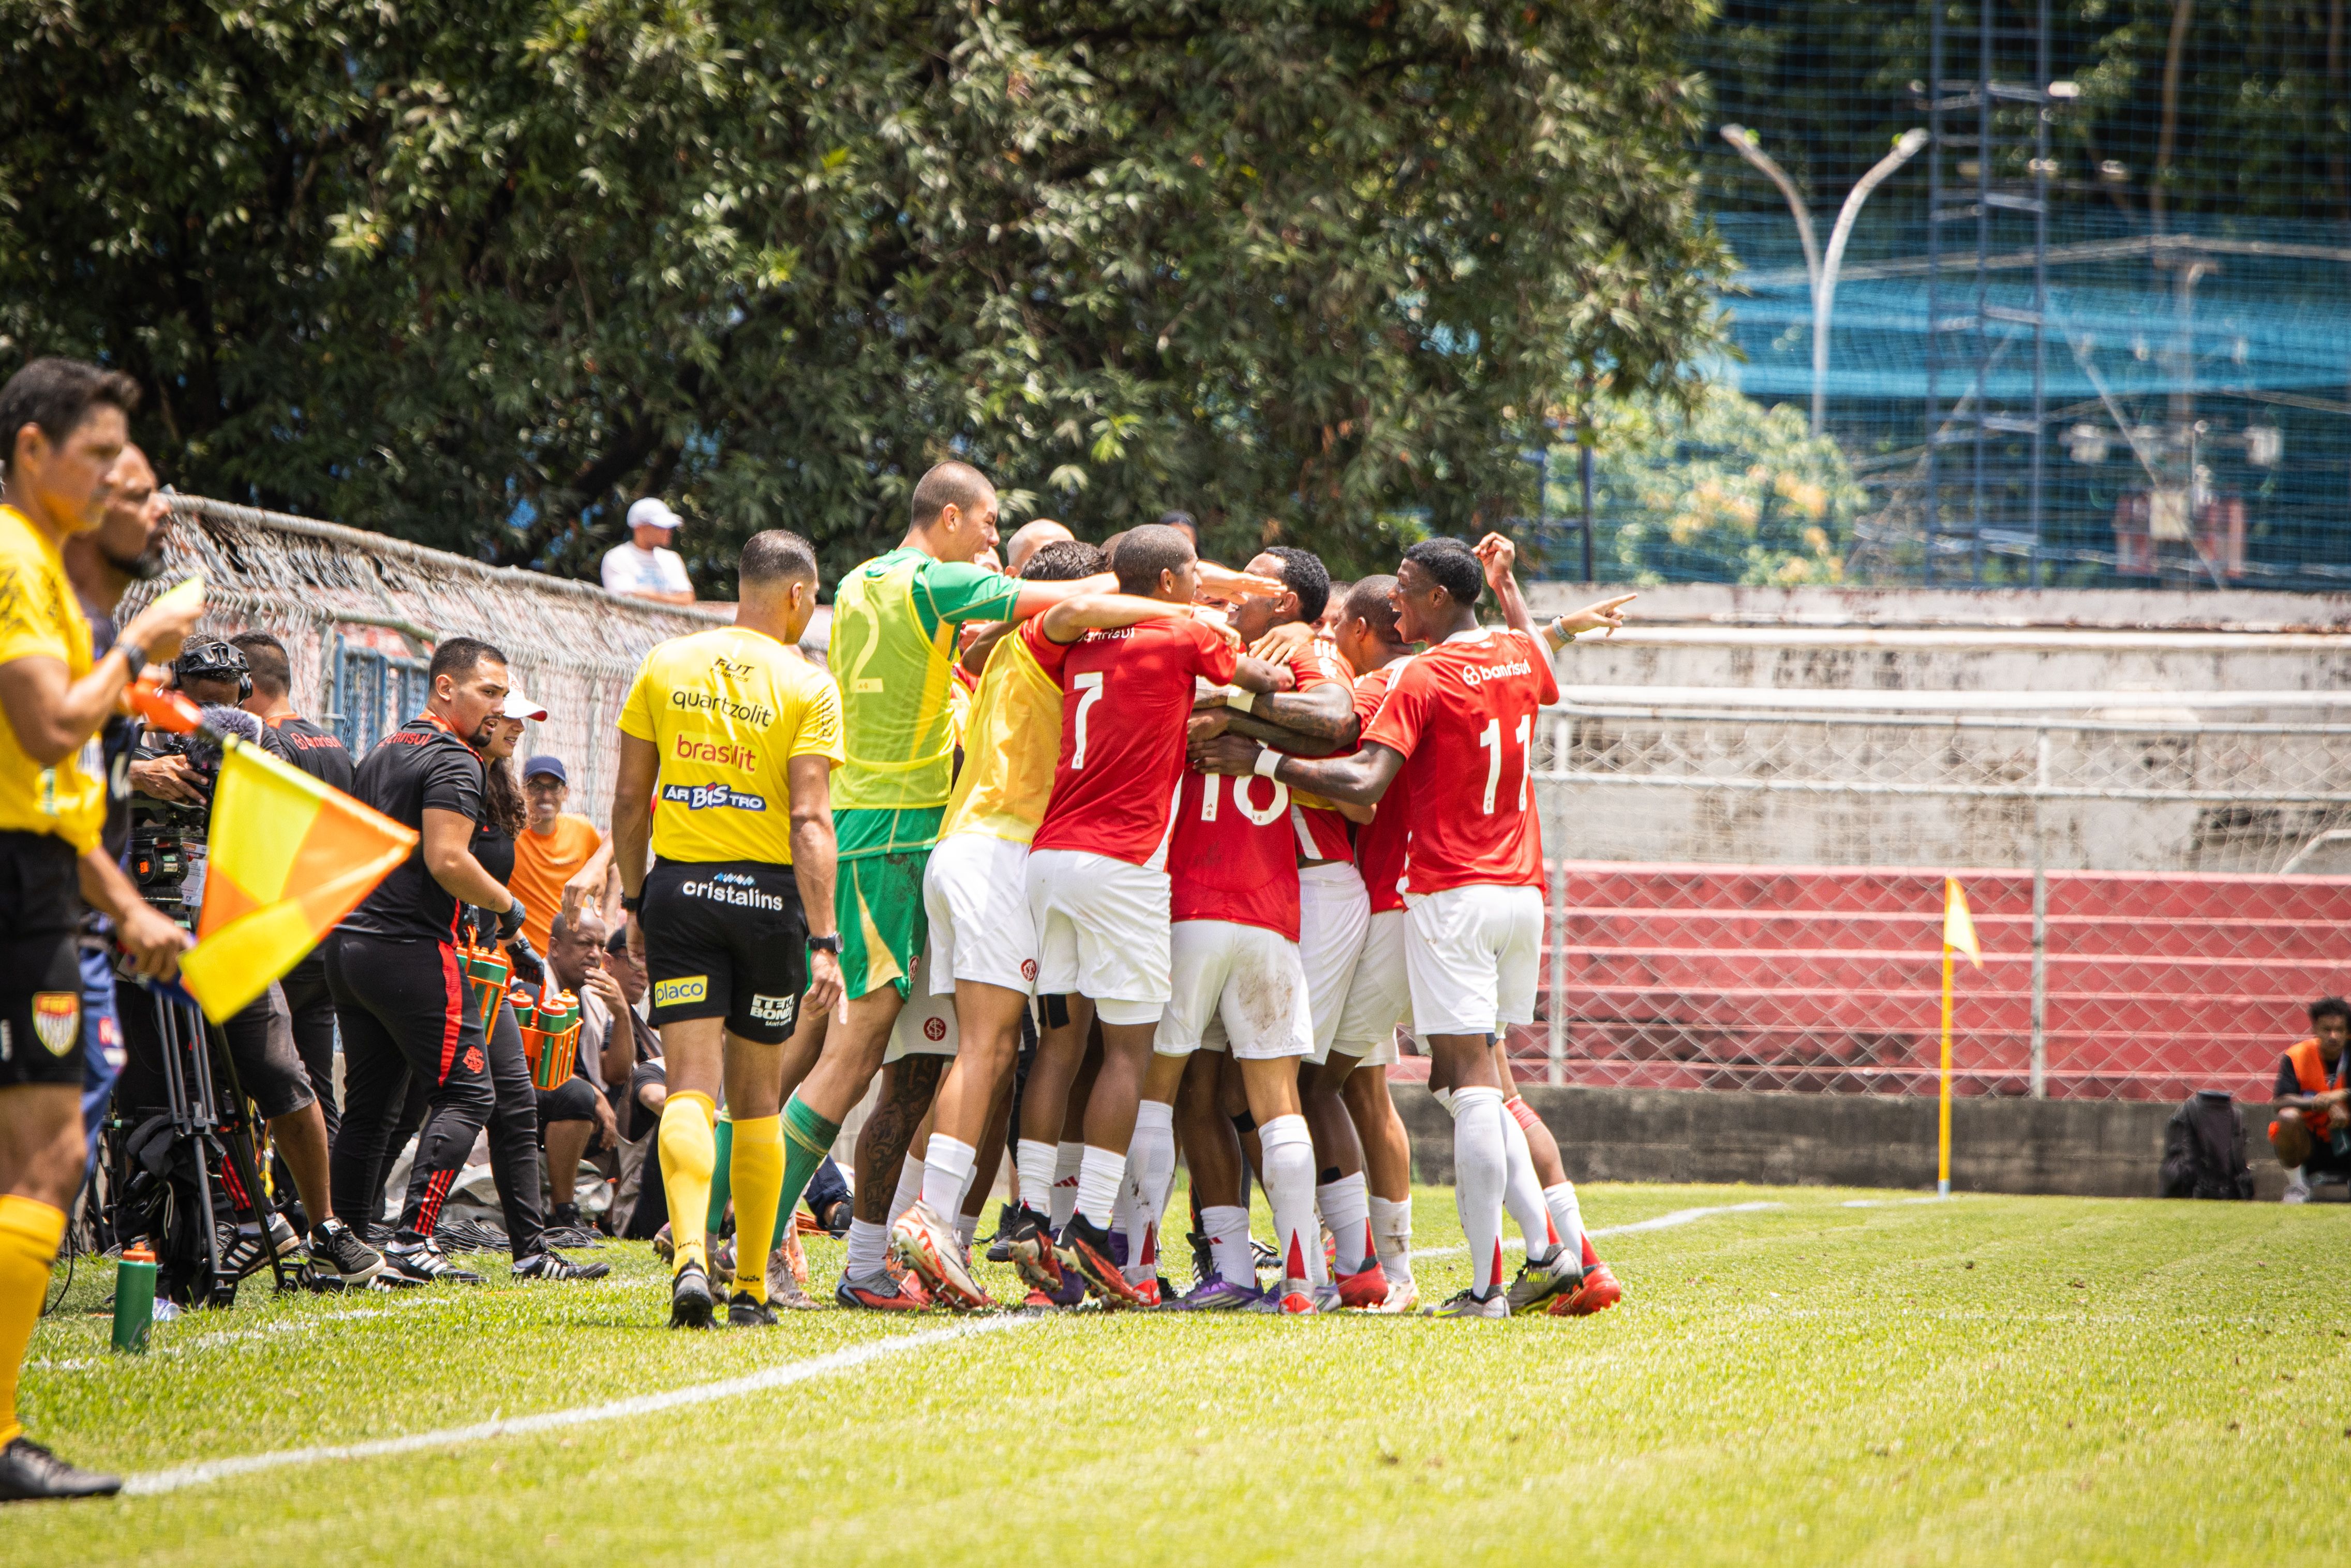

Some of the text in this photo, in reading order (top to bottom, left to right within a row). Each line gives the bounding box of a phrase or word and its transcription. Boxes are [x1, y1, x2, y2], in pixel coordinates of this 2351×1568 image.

[843, 599, 884, 693] 2
[715, 658, 754, 675] FUT
[1479, 659, 1531, 680] banrisul
[672, 691, 771, 727] quartzolit
[1071, 671, 1103, 770] 7
[677, 734, 756, 772] brasilit
[1480, 714, 1530, 814] 11
[682, 881, 783, 911] cristalins
[656, 982, 704, 1002] placo
